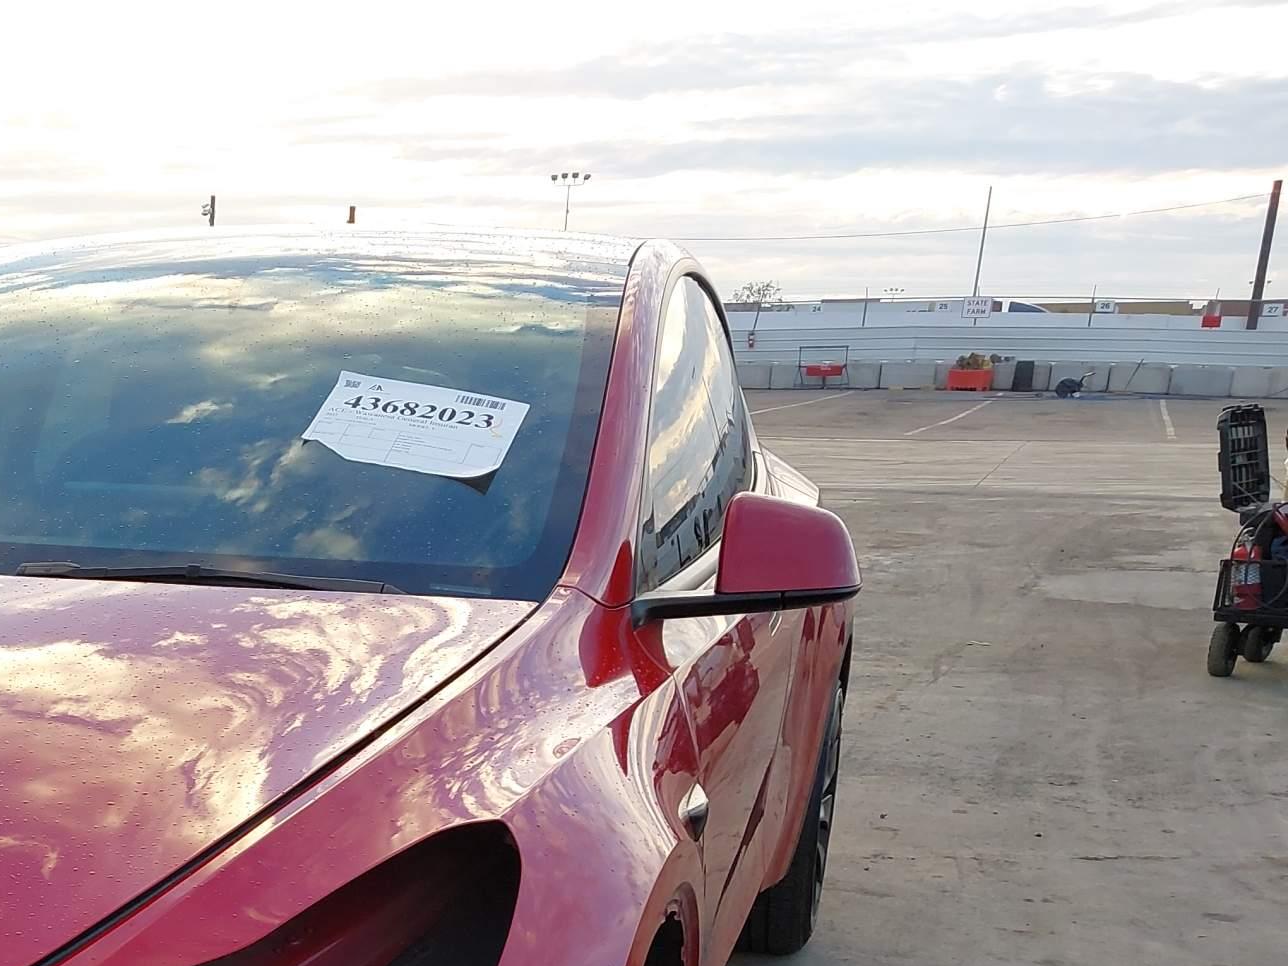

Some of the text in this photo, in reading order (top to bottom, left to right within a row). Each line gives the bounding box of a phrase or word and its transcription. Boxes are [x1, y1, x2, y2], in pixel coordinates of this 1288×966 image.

[967, 299, 988, 307] STATE
[1100, 302, 1111, 310] 26
[1267, 306, 1280, 314] 27
[343, 395, 494, 429] 43682023
